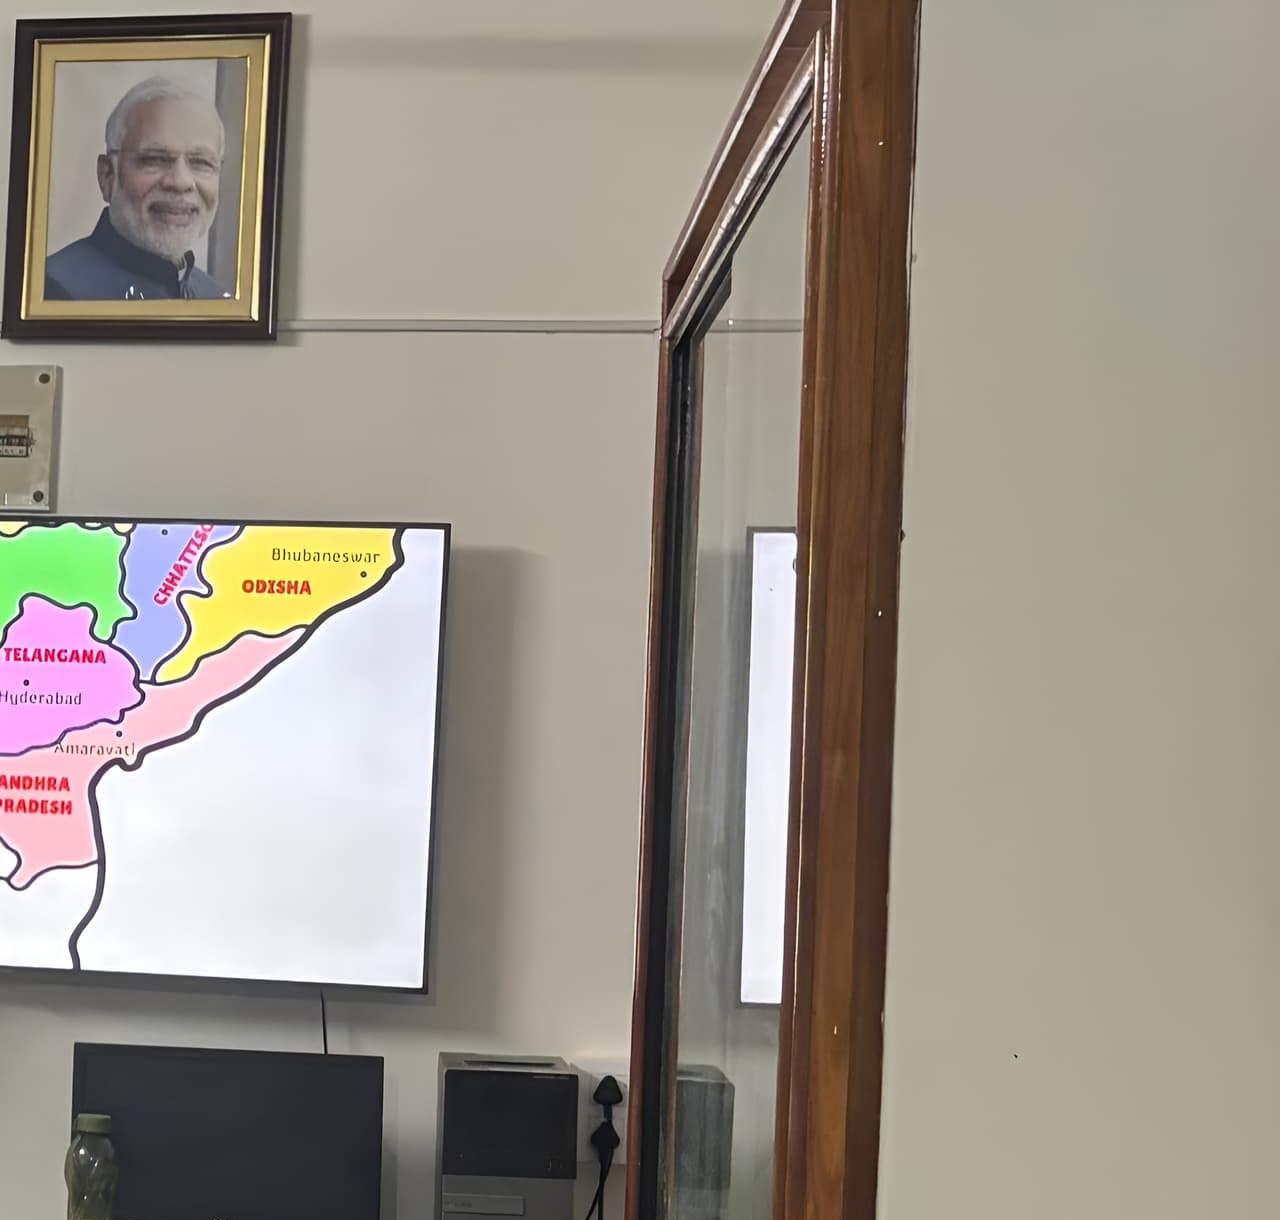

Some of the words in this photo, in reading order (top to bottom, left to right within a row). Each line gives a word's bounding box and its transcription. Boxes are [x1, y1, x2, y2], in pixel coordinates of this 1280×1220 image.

[272, 547, 381, 563] Bhubaneswar
[241, 579, 312, 596] ODISHA
[3, 647, 107, 664] TELANGANA
[54, 742, 135, 756] Amaravati
